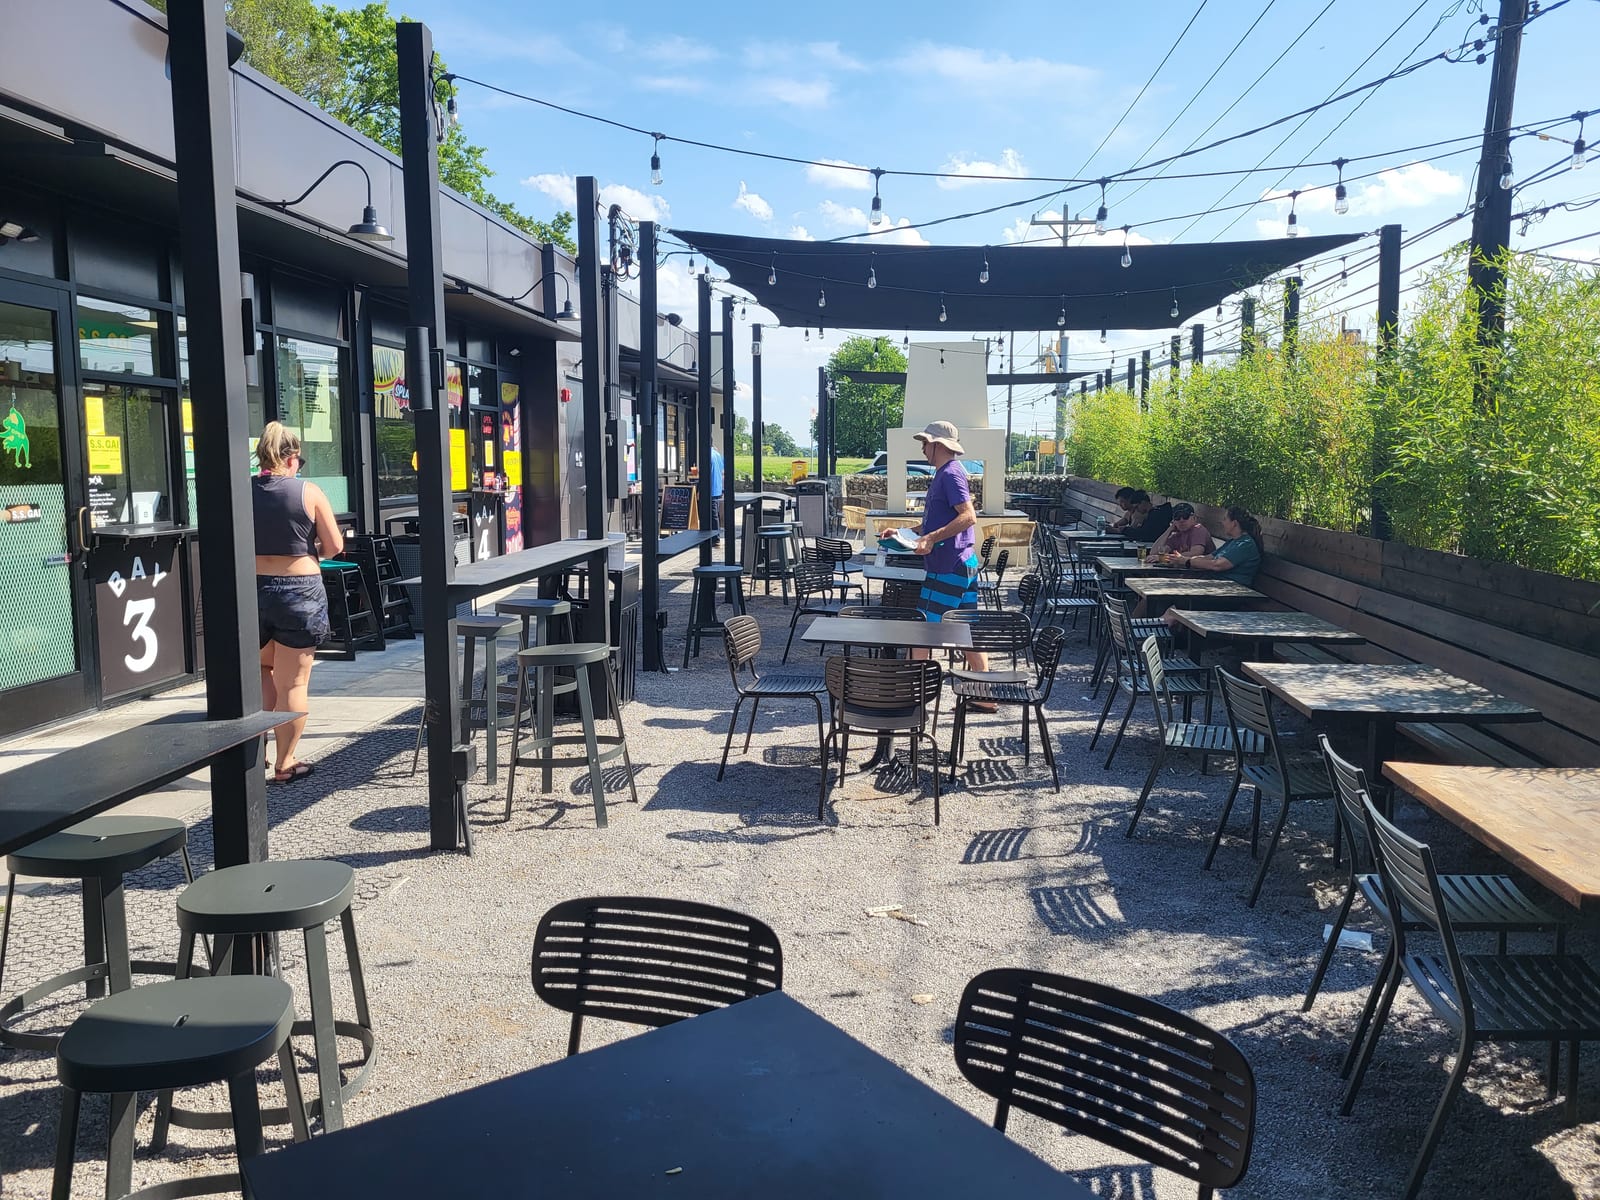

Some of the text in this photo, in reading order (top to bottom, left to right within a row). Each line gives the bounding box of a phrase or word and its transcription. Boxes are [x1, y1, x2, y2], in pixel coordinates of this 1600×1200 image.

[395, 384, 409, 399] SPLA
[12, 508, 41, 519] S.S. GAI
[476, 505, 495, 527] BAY
[478, 529, 490, 560] 4
[107, 556, 168, 598] BAY
[123, 597, 159, 673] 3
